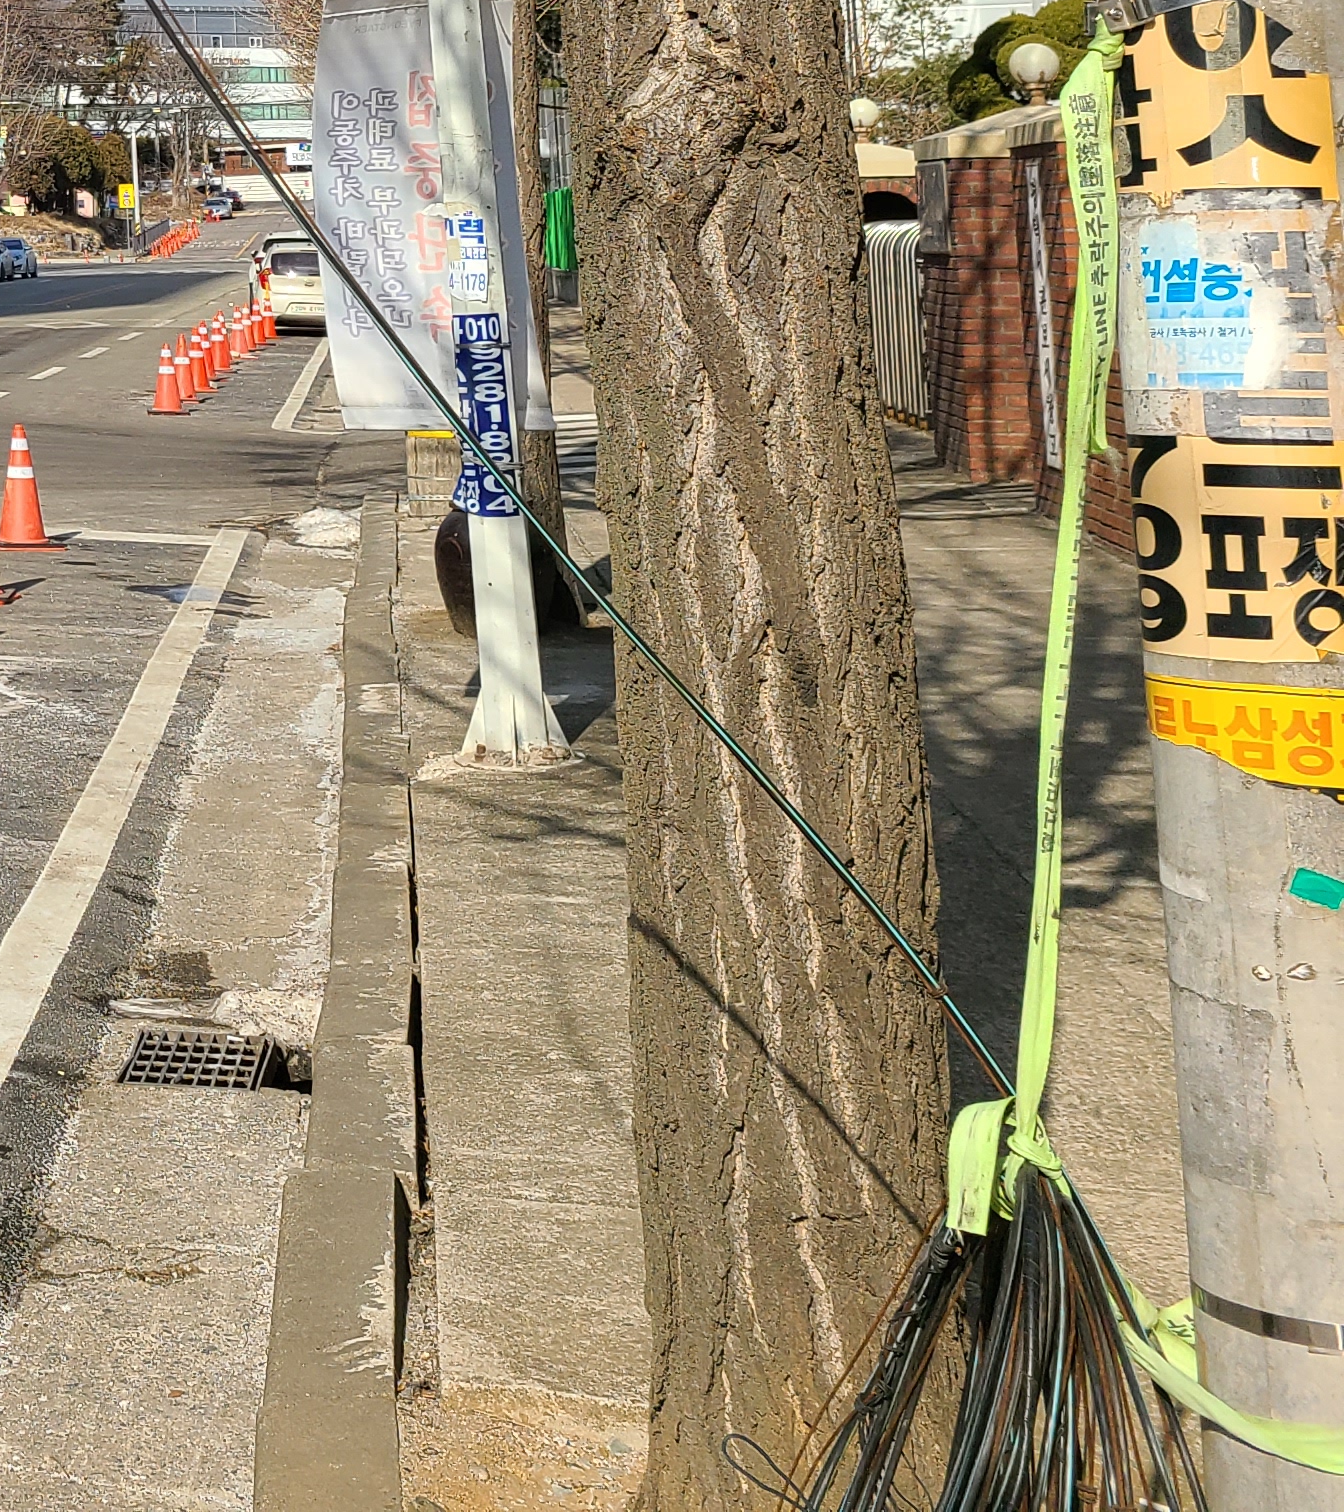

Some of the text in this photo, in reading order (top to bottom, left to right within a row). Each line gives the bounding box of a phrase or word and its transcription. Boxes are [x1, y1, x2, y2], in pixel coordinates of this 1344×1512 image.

[1080, 189, 1112, 287] 추락주의
[465, 315, 500, 342] 010
[1092, 291, 1109, 347] LINE
